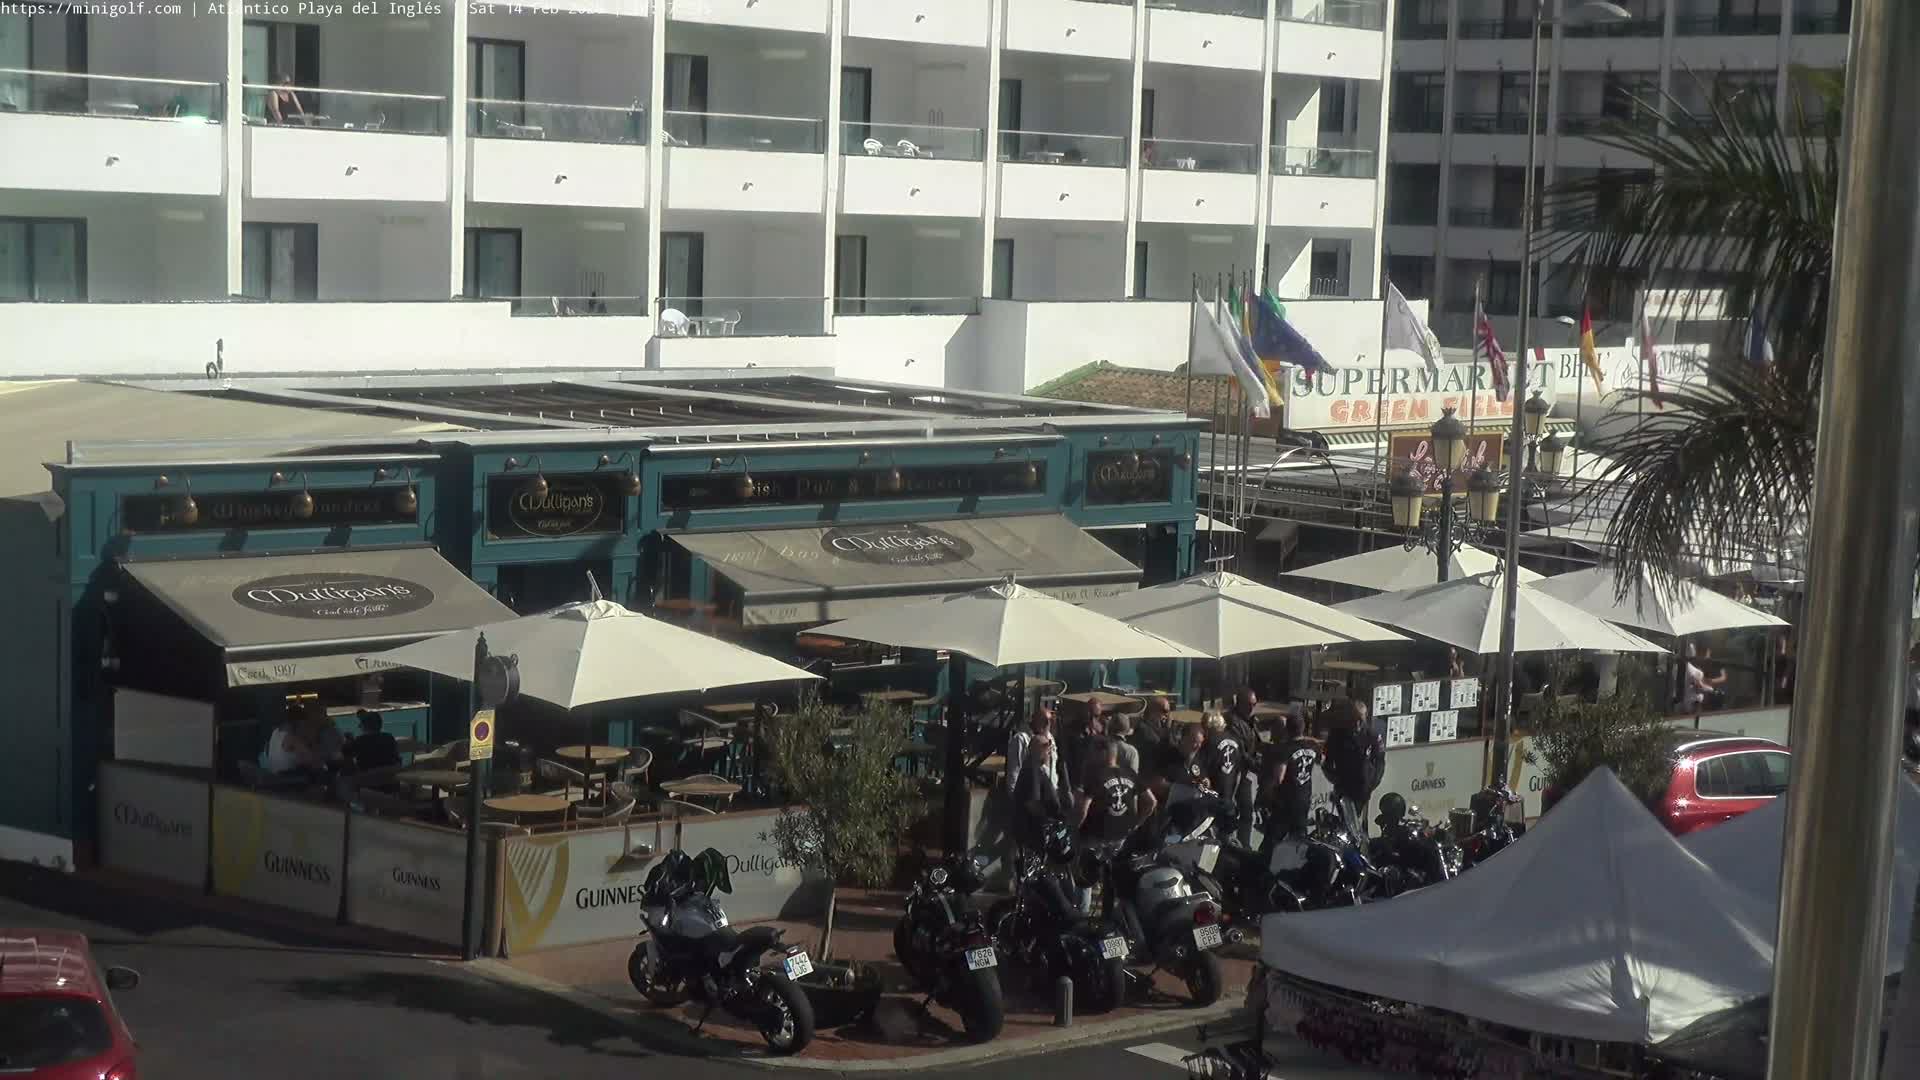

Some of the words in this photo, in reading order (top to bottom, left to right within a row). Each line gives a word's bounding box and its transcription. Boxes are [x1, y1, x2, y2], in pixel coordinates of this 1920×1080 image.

[1292, 363, 1553, 397] SUPERMART
[1330, 399, 1429, 423] GREEN
[519, 492, 594, 512] Mulligan's
[832, 535, 954, 551] Mulligan's
[247, 584, 411, 603] Mulligan's
[264, 850, 333, 884] GUINNESS
[392, 866, 441, 889] GUINNESS
[576, 884, 648, 909] GUINNES
[789, 953, 808, 967] 7442
